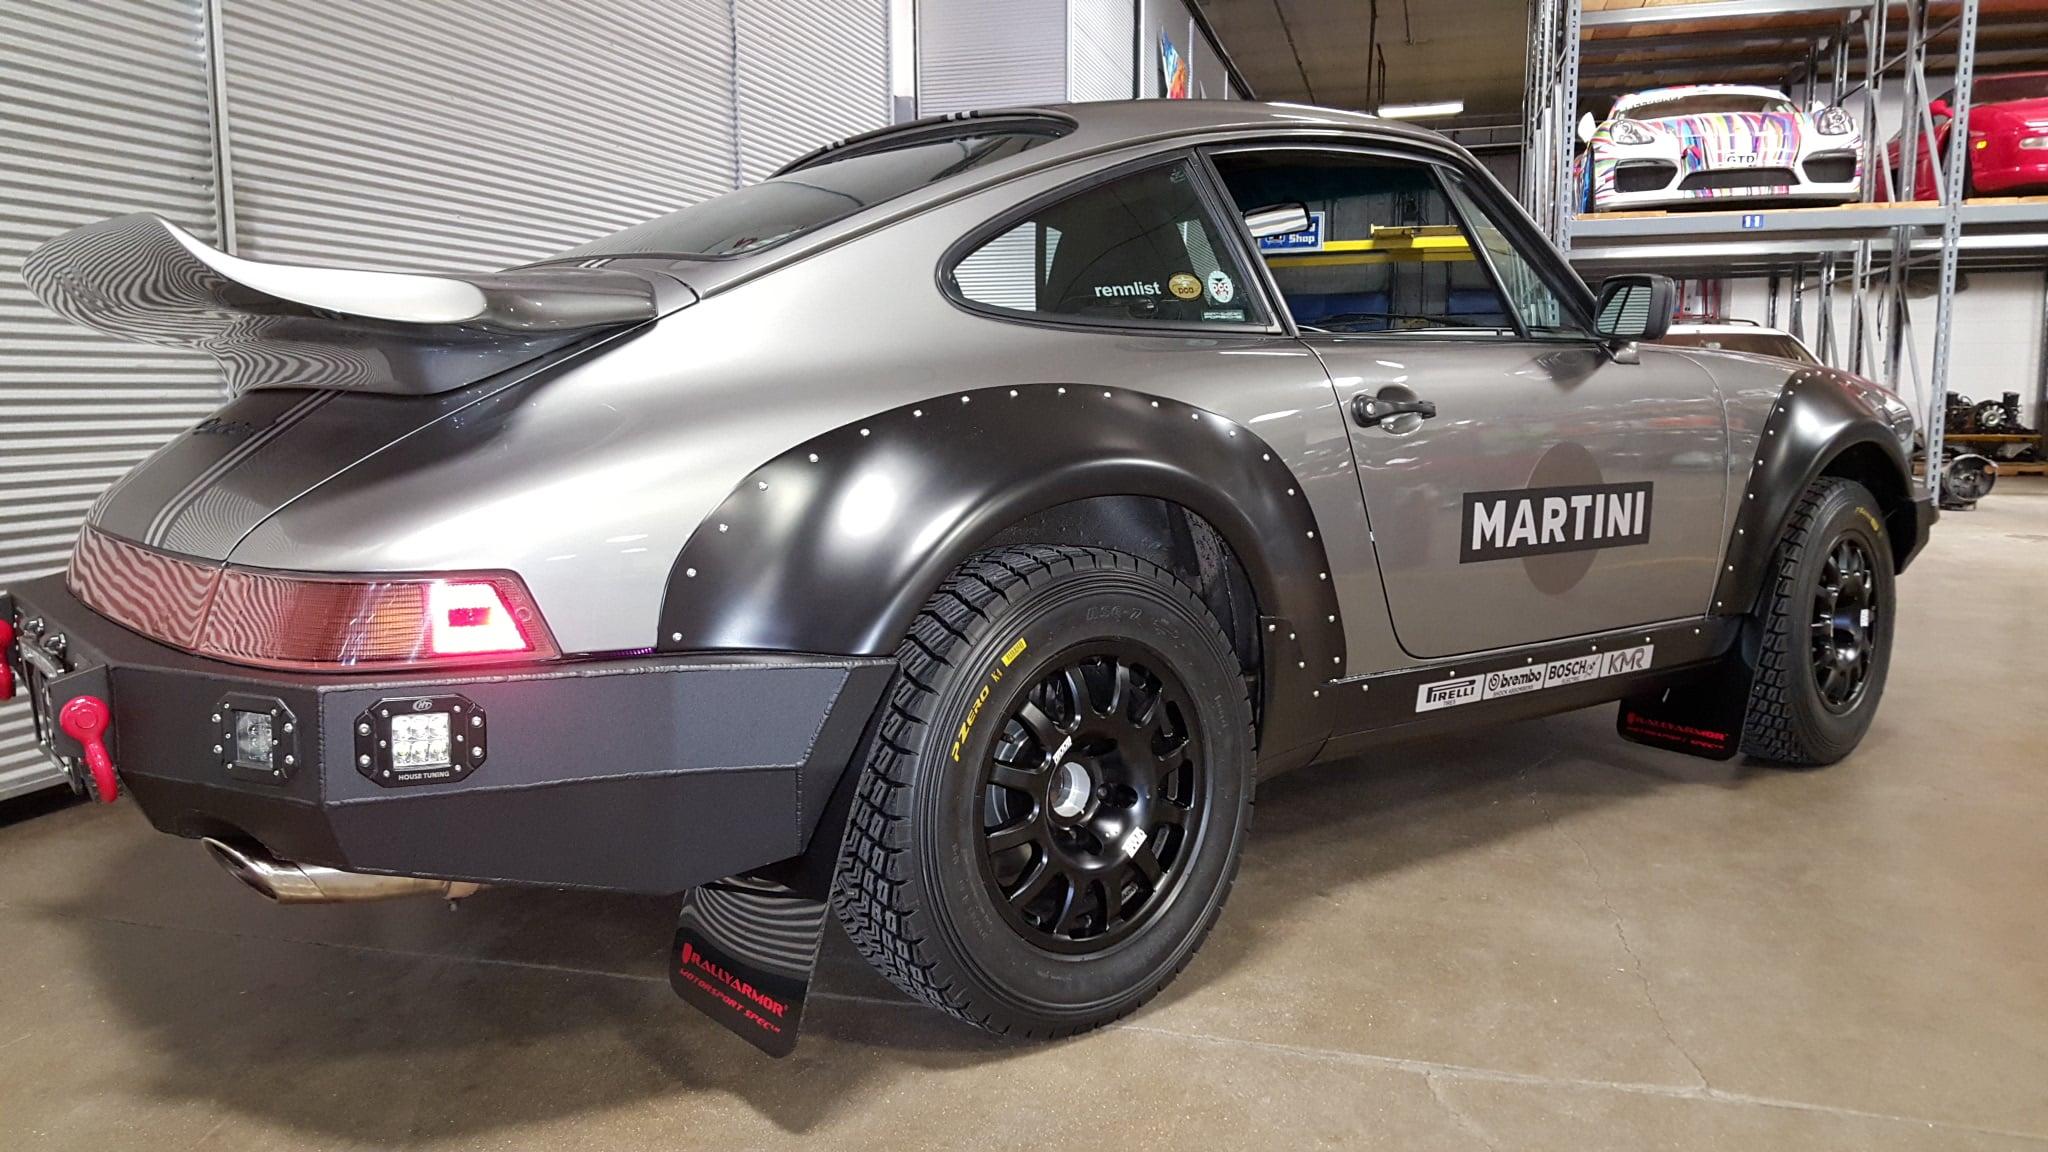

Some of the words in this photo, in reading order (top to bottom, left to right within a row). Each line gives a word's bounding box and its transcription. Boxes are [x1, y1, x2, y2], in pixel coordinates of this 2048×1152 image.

[1289, 233, 1315, 245] Shop
[1094, 281, 1162, 297] rennlist
[1471, 491, 1645, 550] MARTINI
[1548, 659, 1587, 680] BOSCH
[1607, 647, 1645, 675] KMR
[1500, 668, 1541, 688] brembo
[1426, 679, 1476, 703] PIRELLI
[398, 773, 422, 781] HOUSE
[423, 770, 450, 779] TUNING
